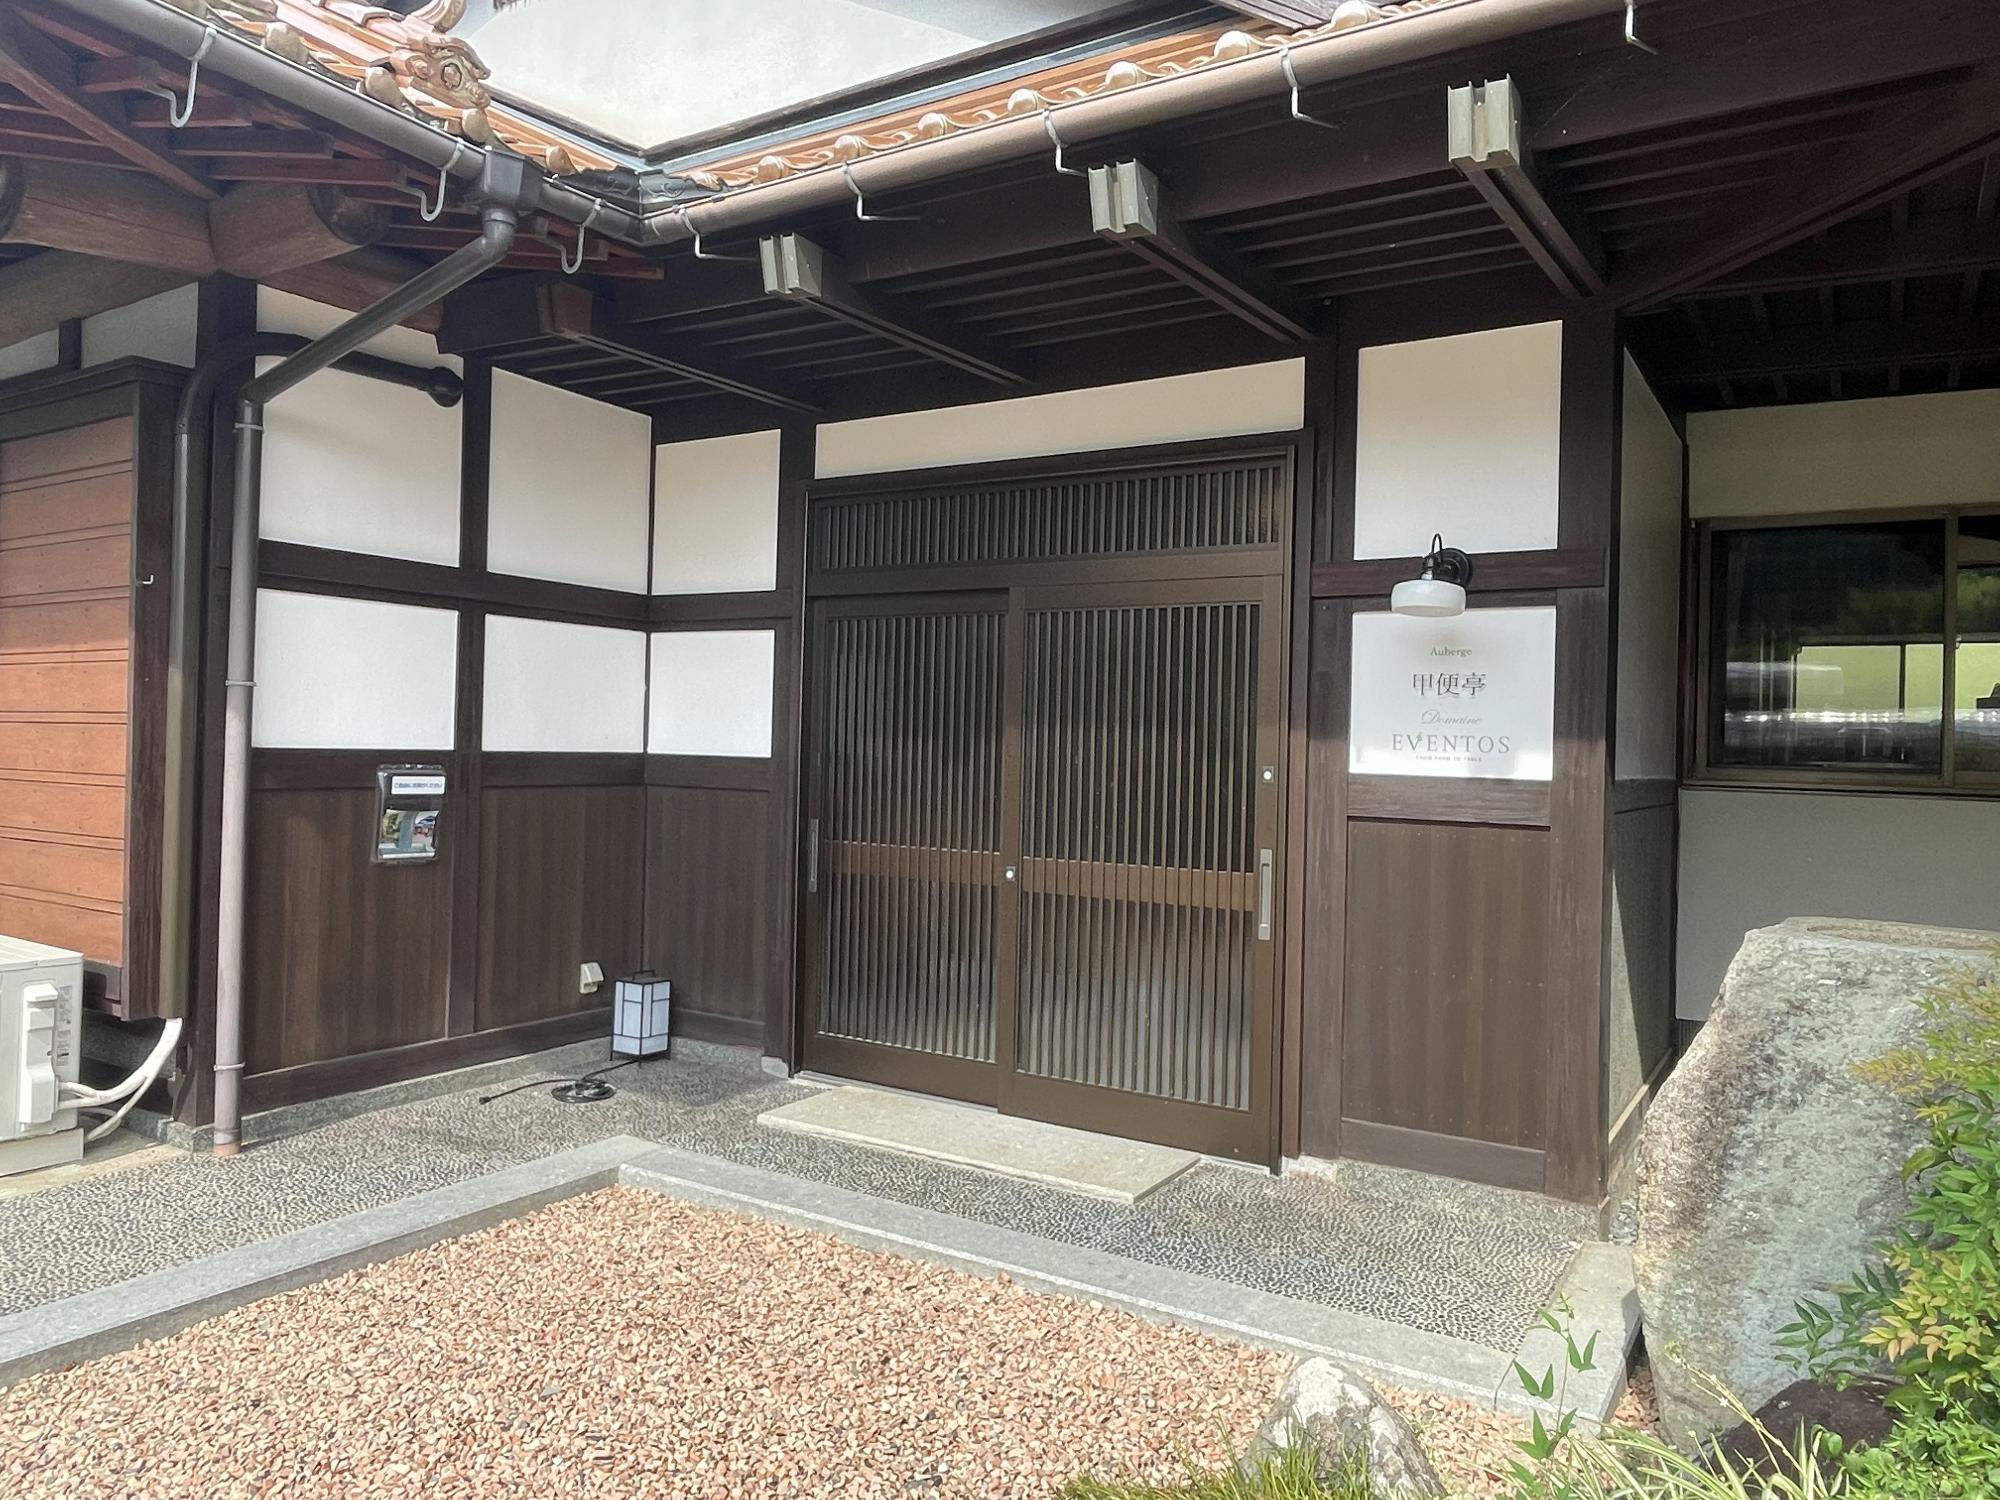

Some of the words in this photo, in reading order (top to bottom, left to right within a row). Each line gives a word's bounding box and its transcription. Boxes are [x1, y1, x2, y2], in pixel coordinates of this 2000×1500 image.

[1430, 646, 1472, 657] Auberge
[1413, 672, 1486, 696] 甲便亭
[1420, 708, 1482, 725] Domaine
[1391, 732, 1511, 754] EVENTOS
